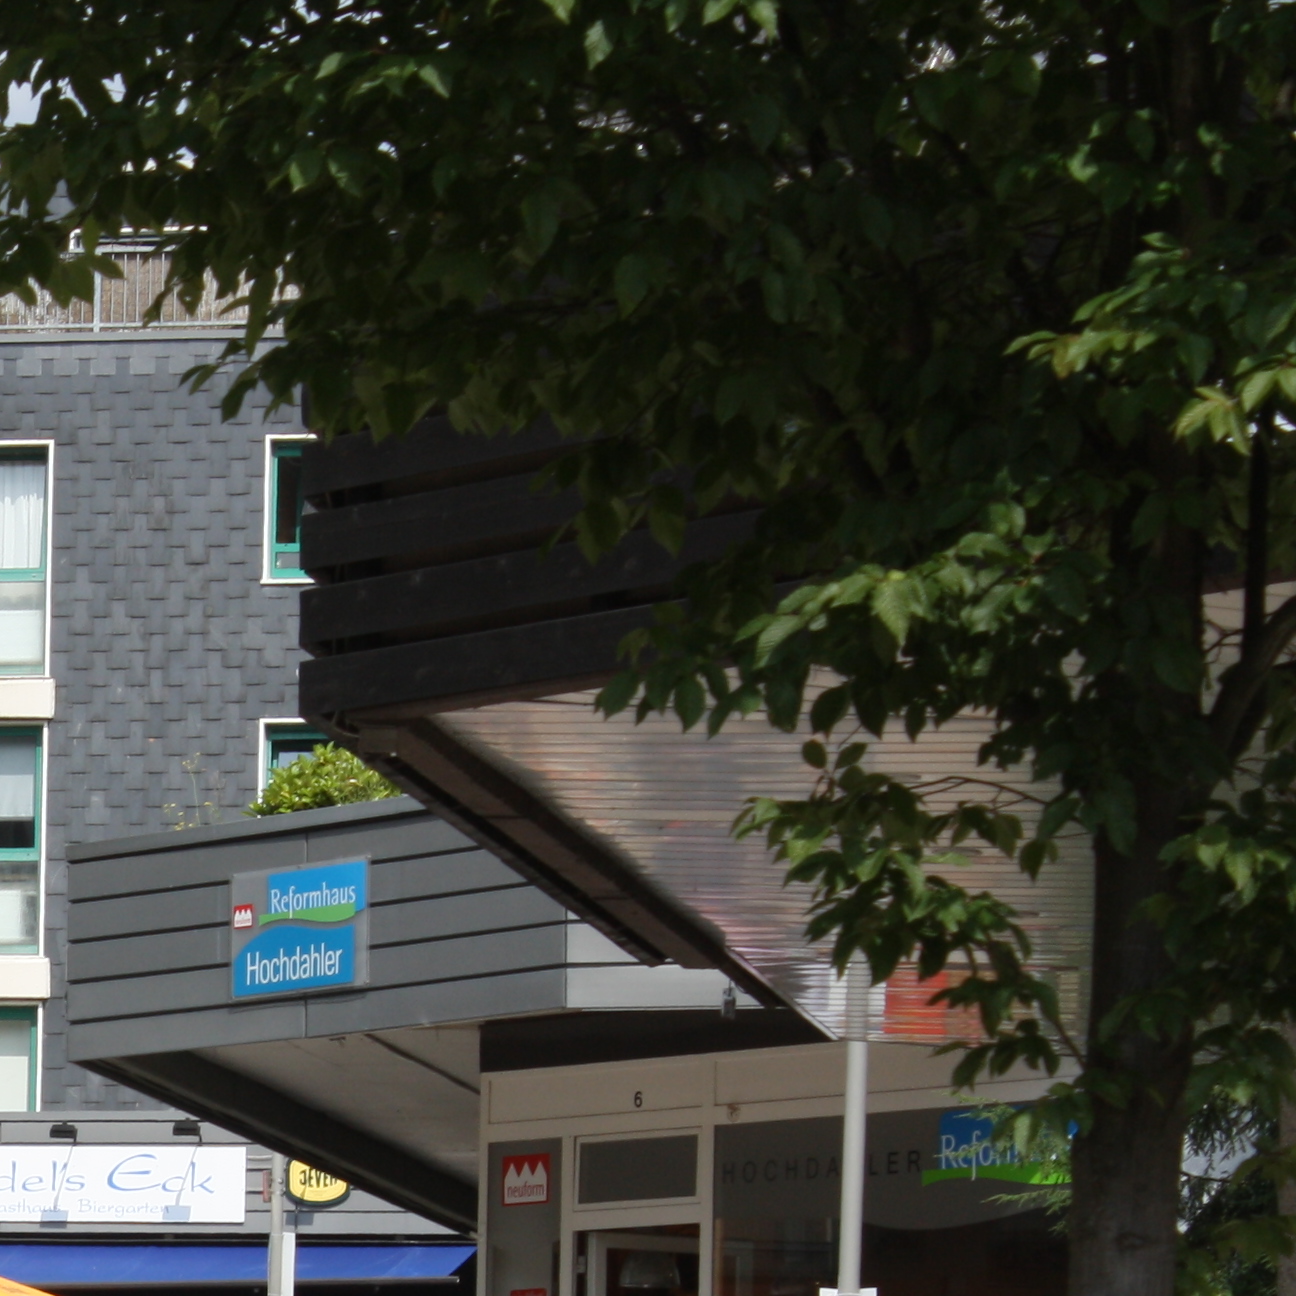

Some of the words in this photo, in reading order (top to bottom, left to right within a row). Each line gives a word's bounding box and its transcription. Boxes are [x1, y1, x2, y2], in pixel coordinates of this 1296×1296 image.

[270, 881, 357, 919] Reformhaus
[246, 942, 344, 986] Hochdahler
[634, 1091, 643, 1108] 6
[106, 1153, 216, 1194] Eck
[722, 1151, 921, 1184] HOCHDALER
[507, 1181, 545, 1199] neuform
[77, 1197, 170, 1217] Biergarten
